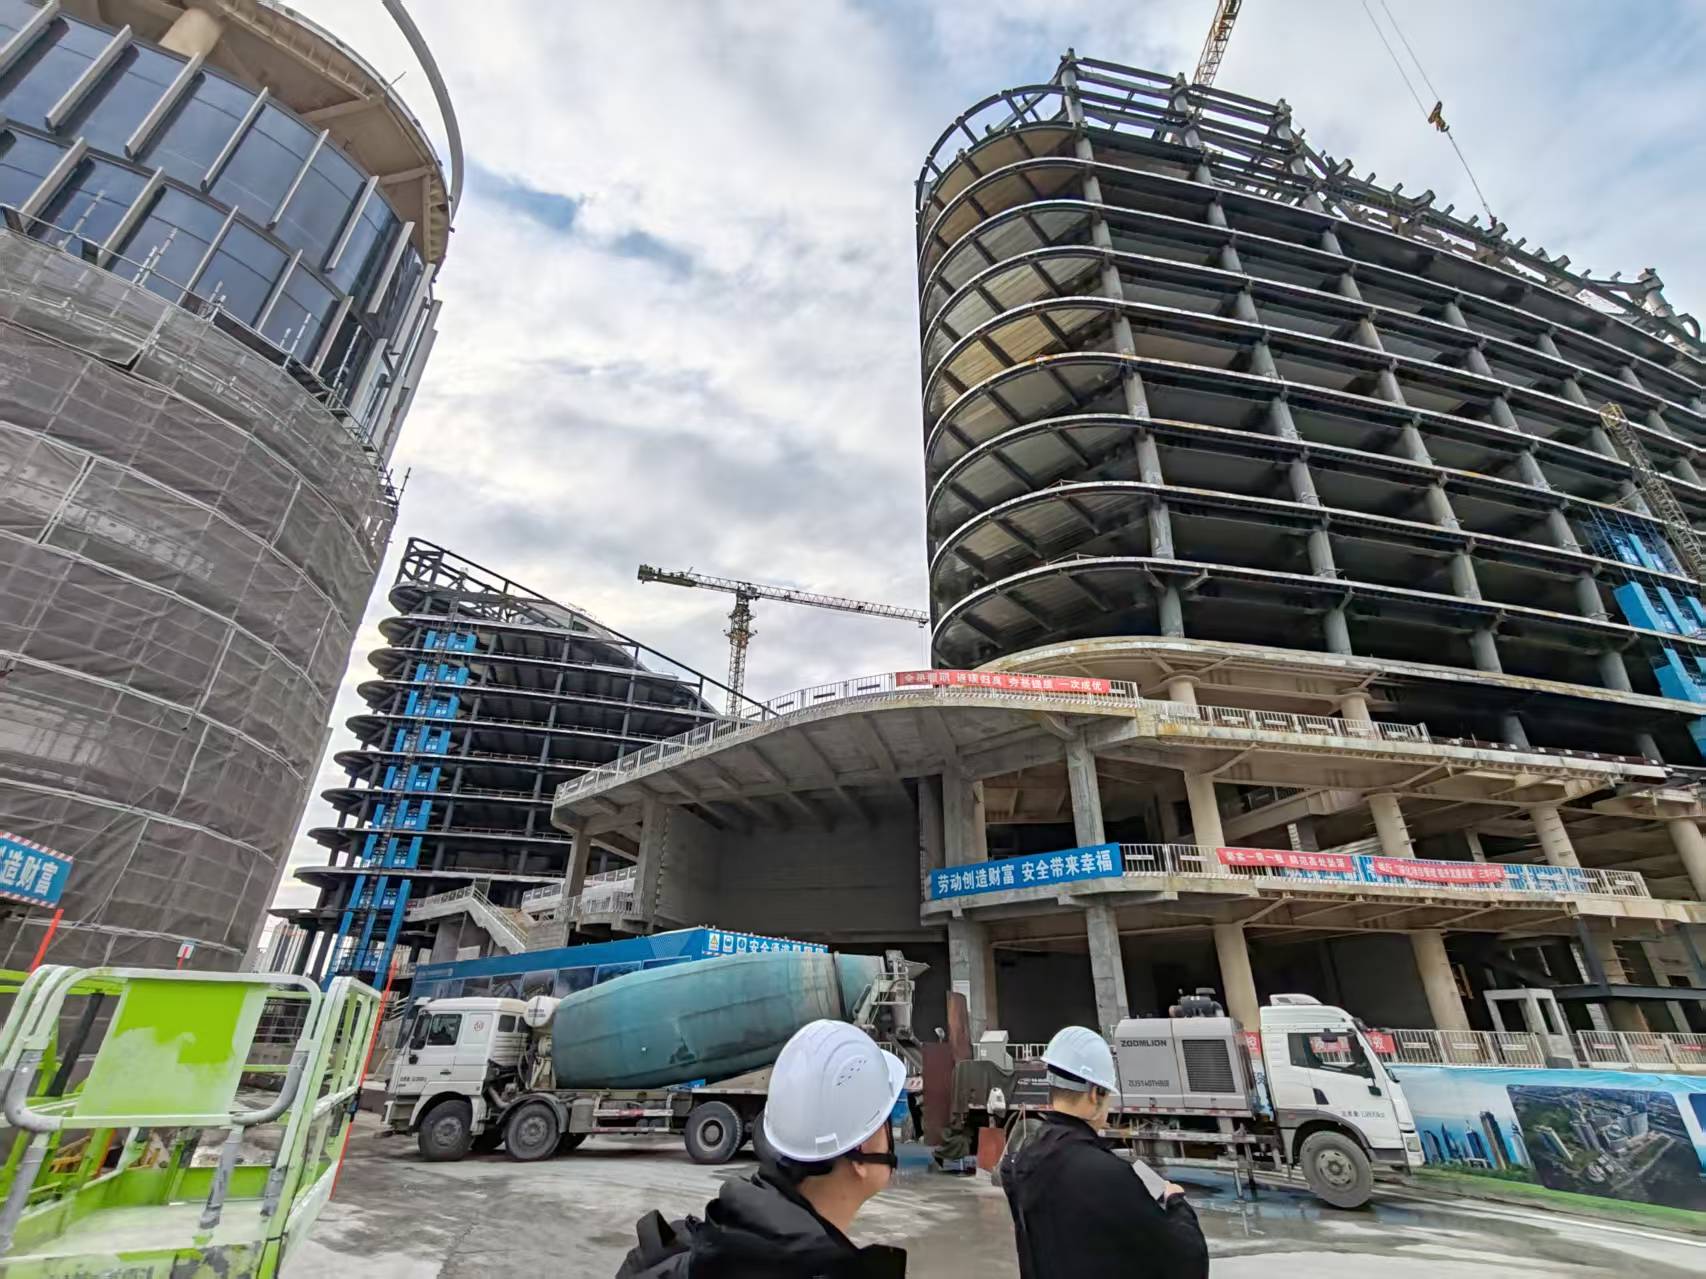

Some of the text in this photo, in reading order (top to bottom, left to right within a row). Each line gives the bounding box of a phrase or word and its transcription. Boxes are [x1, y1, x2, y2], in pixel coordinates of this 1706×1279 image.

[937, 850, 1113, 894] 劳动创造财富 安全带来幸福
[1120, 1039, 1167, 1048] ZOOMLION
